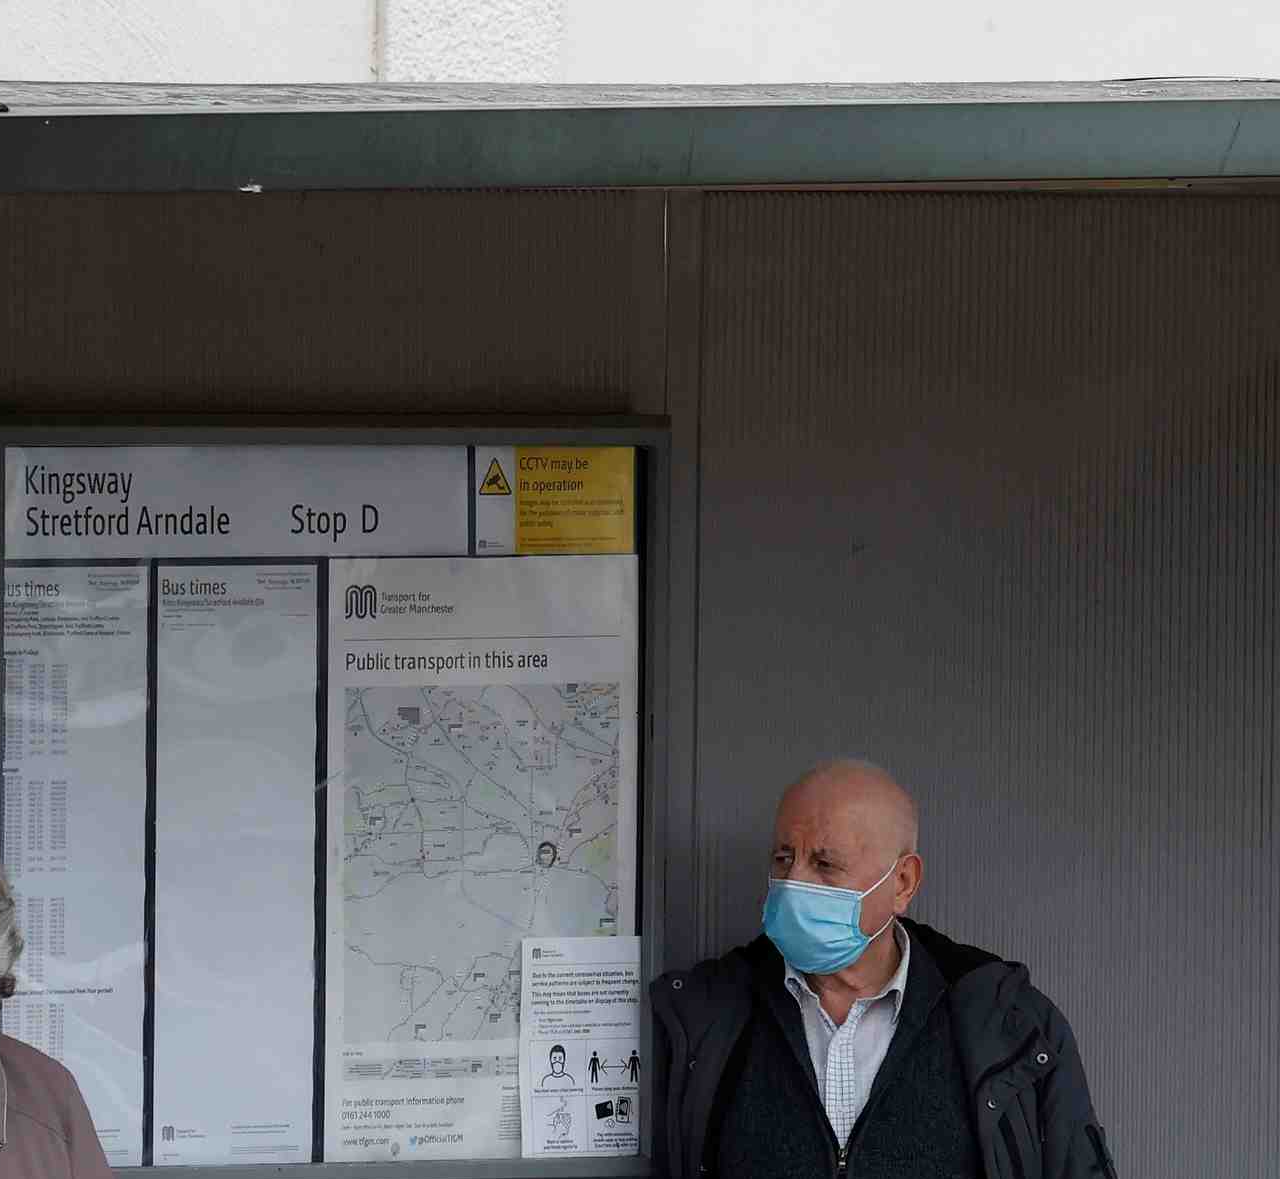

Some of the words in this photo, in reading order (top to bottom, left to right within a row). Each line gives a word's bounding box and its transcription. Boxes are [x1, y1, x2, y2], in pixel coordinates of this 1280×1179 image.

[519, 457, 549, 470] CCTV
[551, 460, 572, 473] may
[575, 457, 589, 470] be
[25, 465, 133, 503] Kingsway
[519, 479, 530, 491] in
[533, 479, 583, 494] operation
[26, 505, 129, 537] Stretford
[137, 504, 231, 536] Arndale
[291, 504, 347, 542] Stop
[361, 505, 379, 534] D
[24, 581, 60, 598] times
[162, 579, 186, 595] Bus
[190, 579, 227, 596] times
[382, 592, 415, 603] Transport
[418, 592, 431, 601] for
[380, 604, 406, 614] Greater
[409, 603, 455, 614] Manchester
[345, 652, 390, 671] Public
[395, 654, 465, 673] transport
[468, 653, 481, 669] in
[485, 651, 515, 669] this
[518, 653, 548, 669] area
[354, 1098, 373, 1109] public
[375, 1098, 404, 1107] transport
[406, 1096, 444, 1105] information
[446, 1097, 465, 1106] phone
[374, 1109, 391, 1119] 1000
